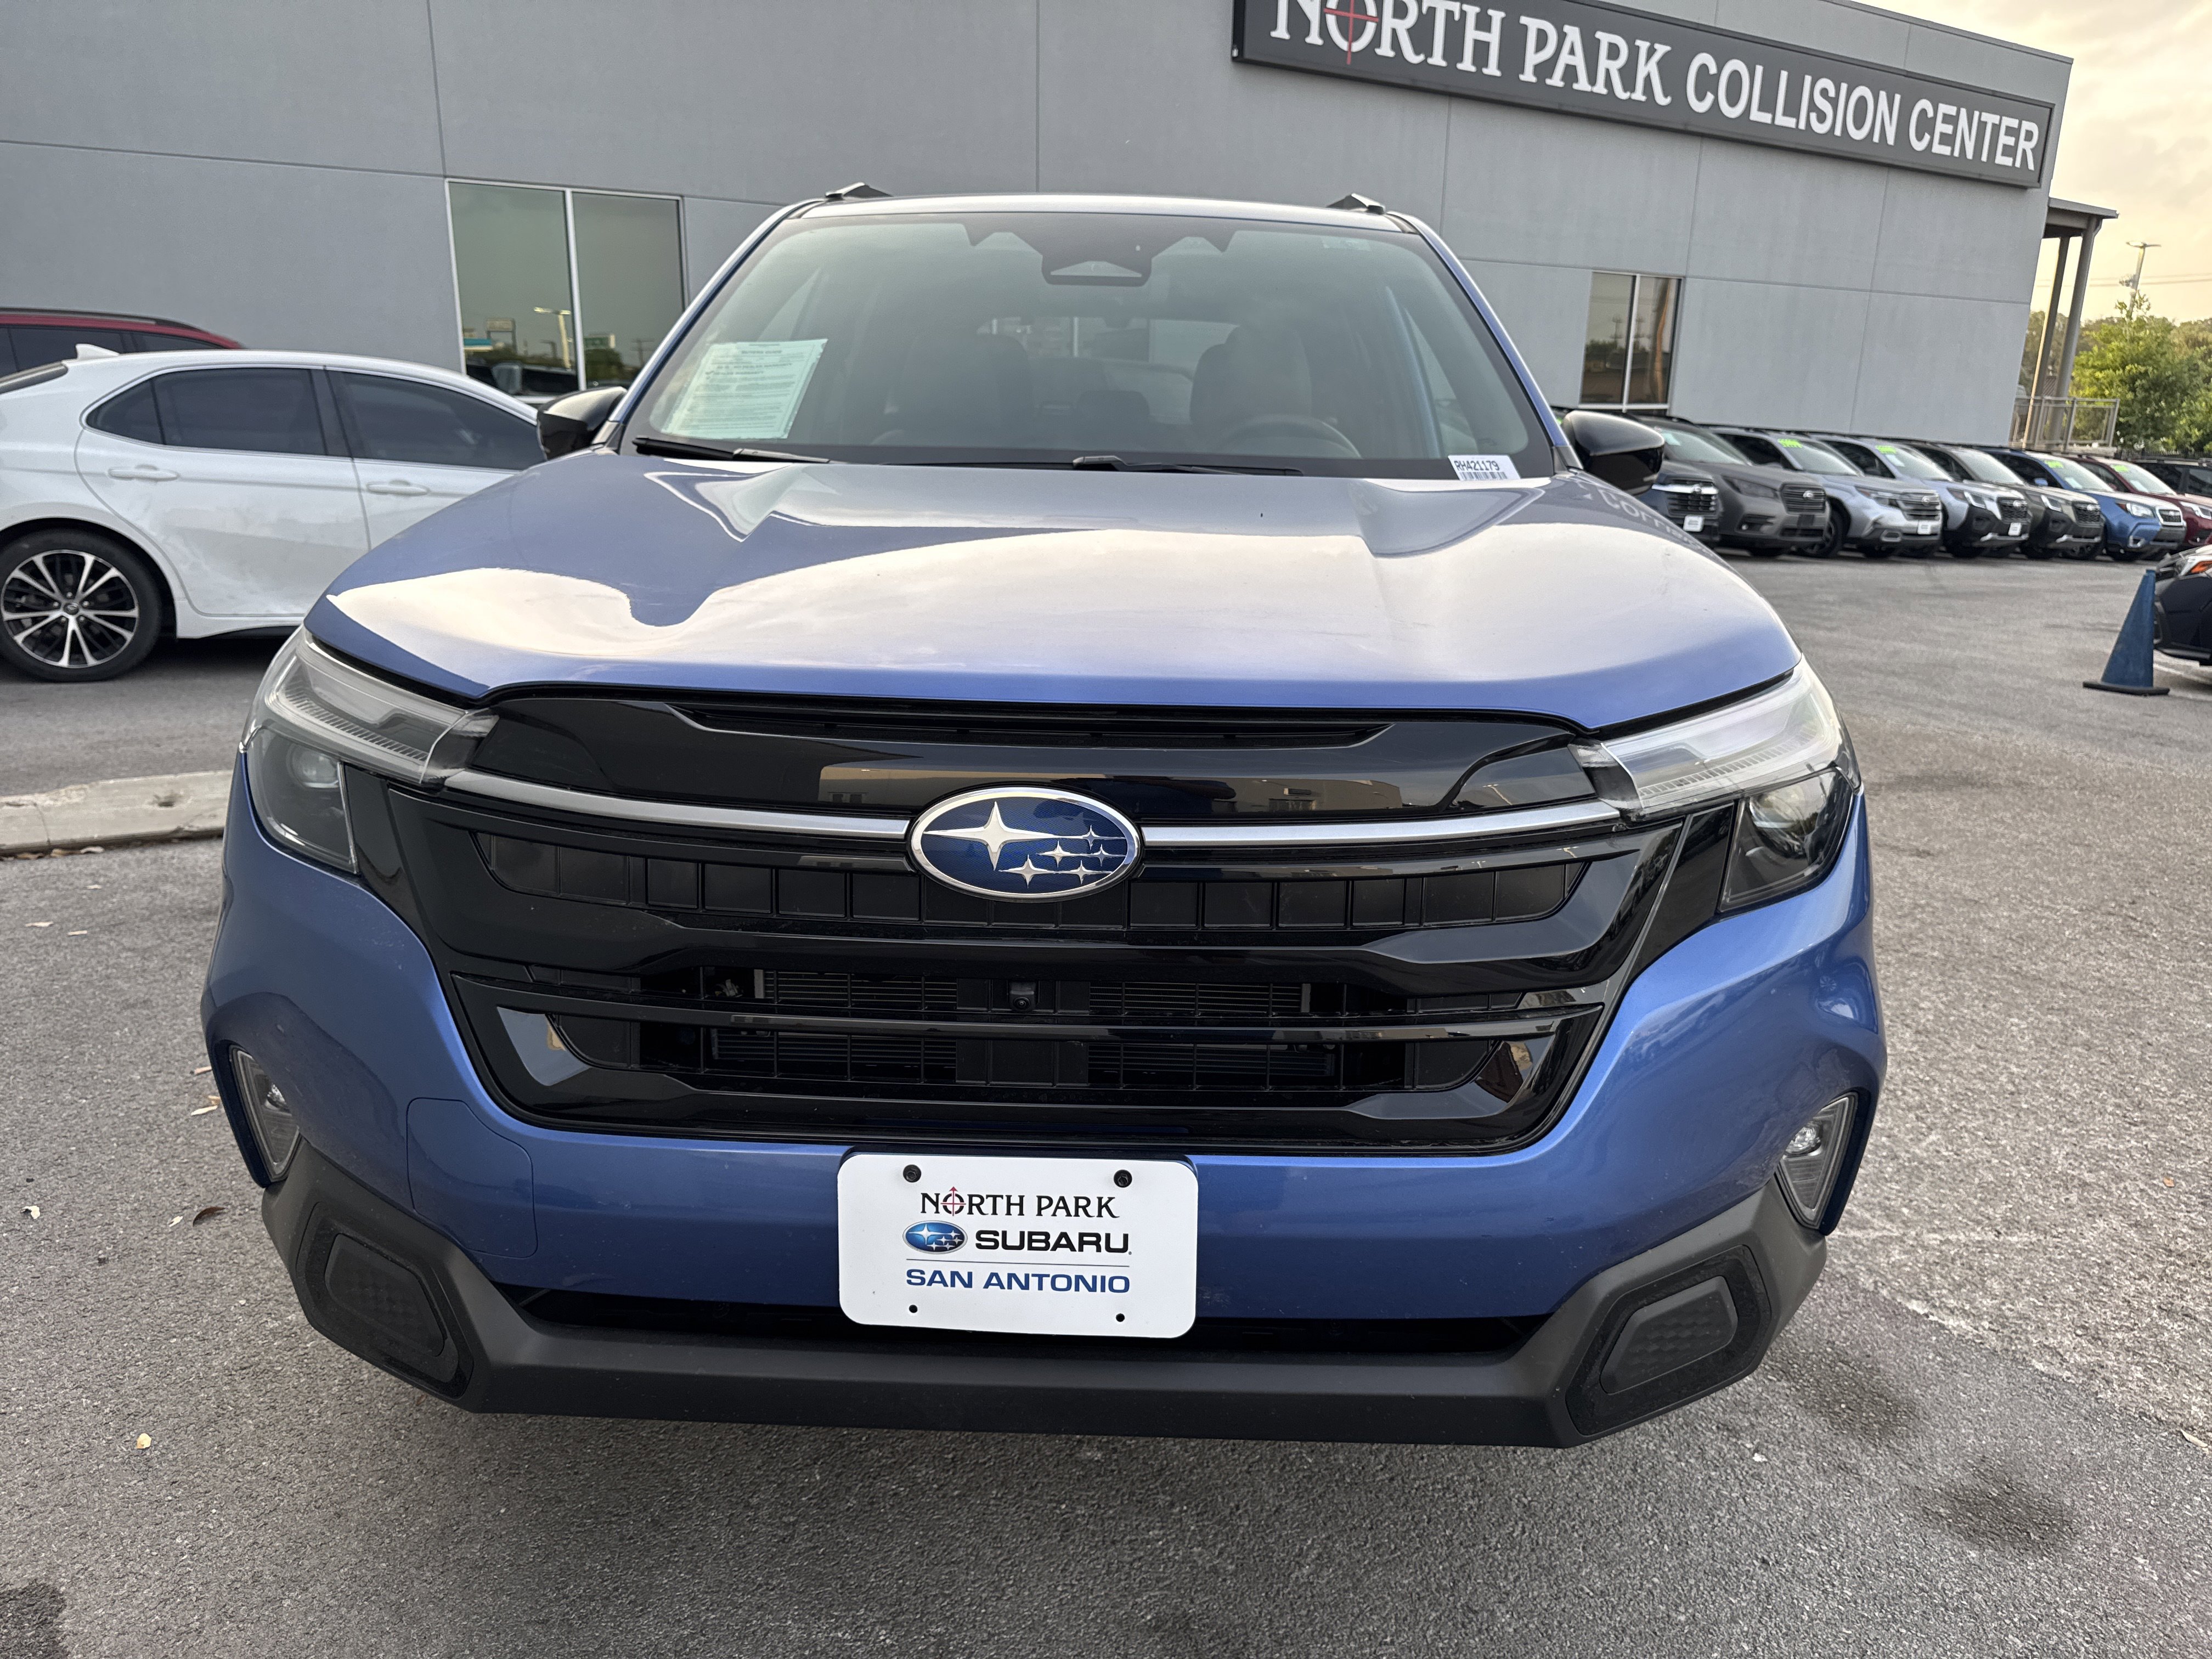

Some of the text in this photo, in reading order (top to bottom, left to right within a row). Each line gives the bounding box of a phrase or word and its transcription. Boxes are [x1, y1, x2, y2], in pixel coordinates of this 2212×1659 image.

[1270, 0, 2039, 171] NORTH PARK COLLISION CENTER
[921, 1187, 1119, 1218] NORTH PARK
[975, 1230, 1128, 1253] SUBARU
[907, 1269, 1130, 1293] SAN ANTONIO
